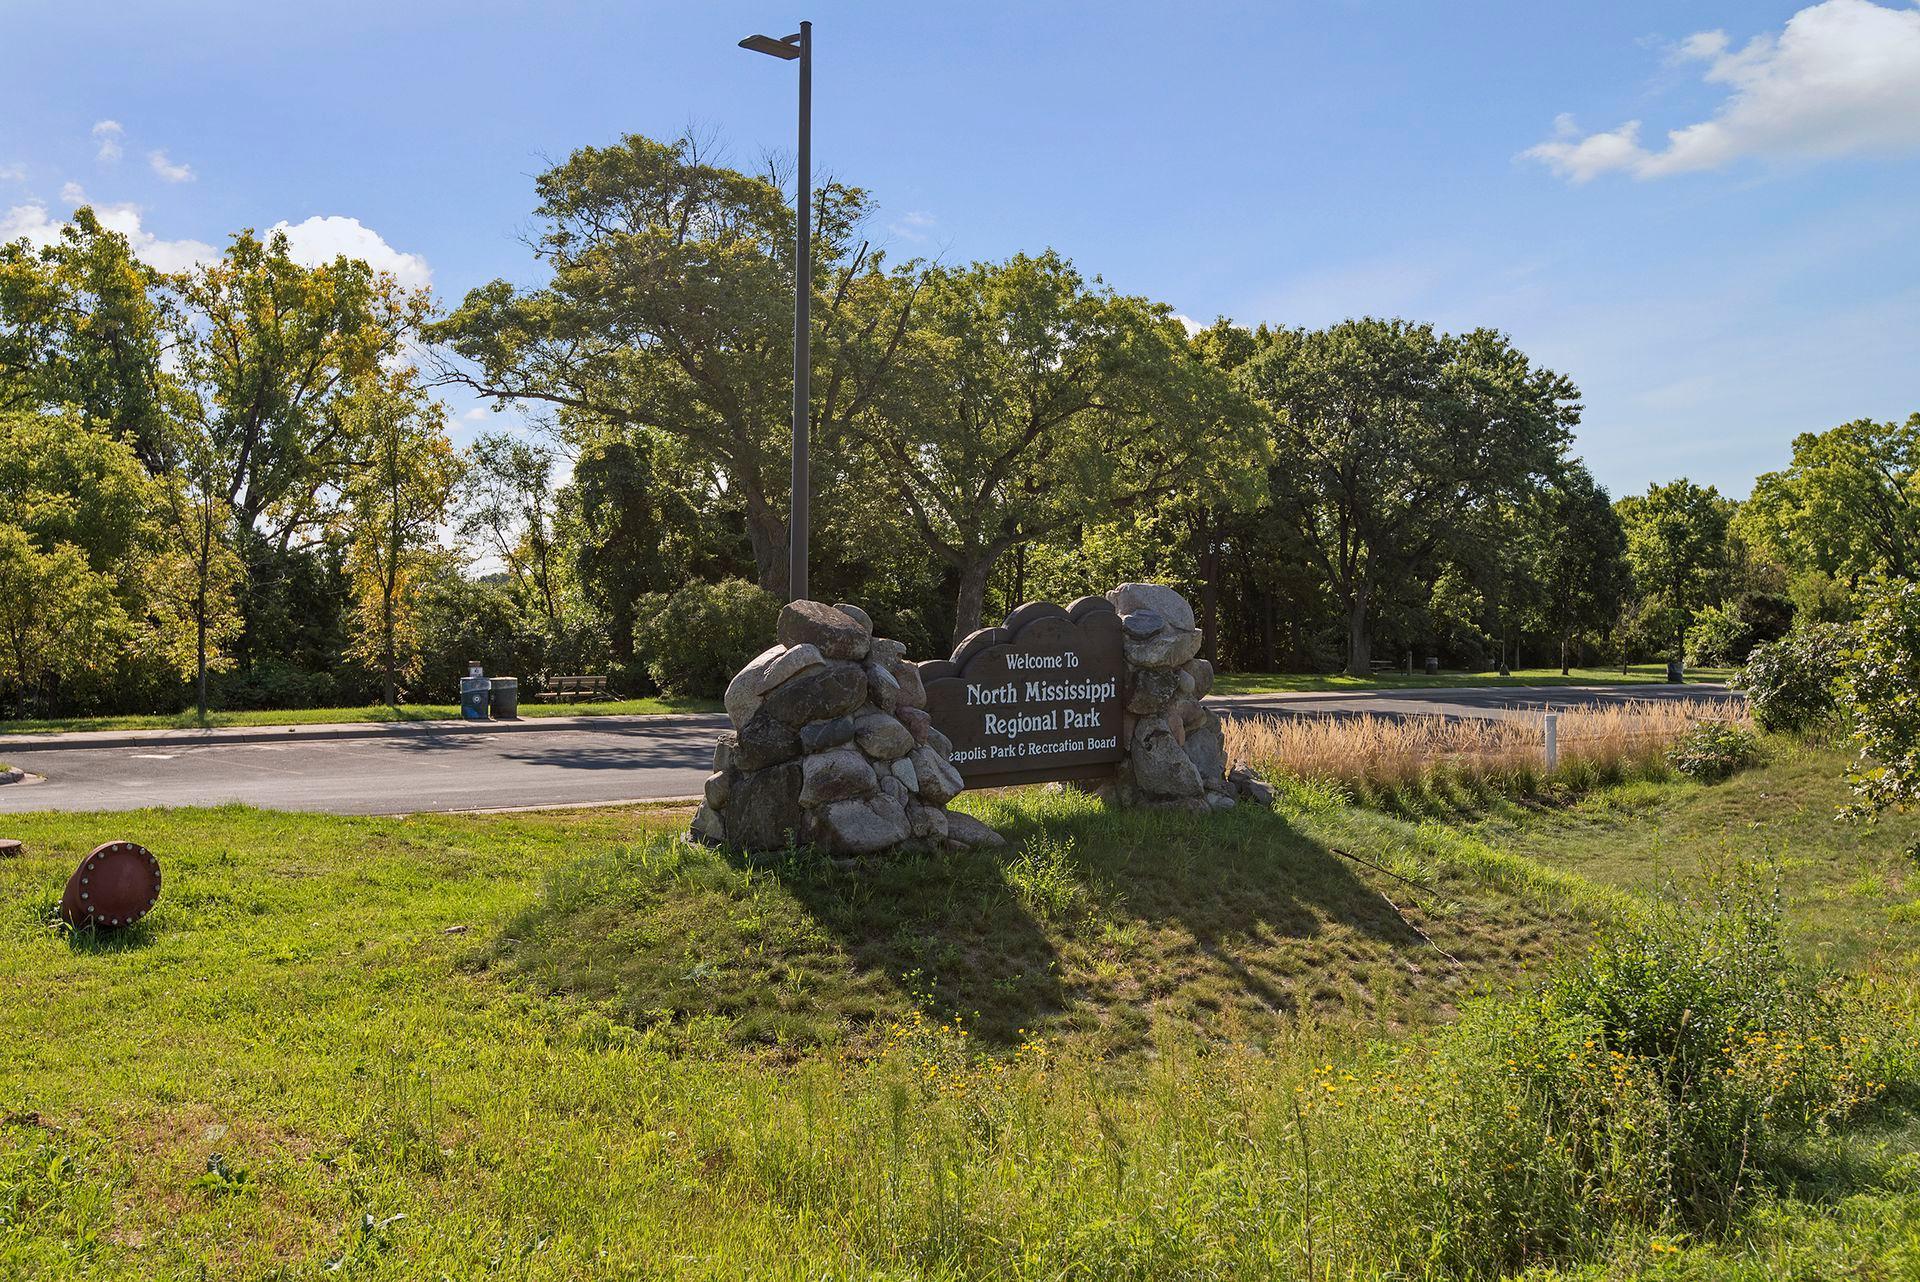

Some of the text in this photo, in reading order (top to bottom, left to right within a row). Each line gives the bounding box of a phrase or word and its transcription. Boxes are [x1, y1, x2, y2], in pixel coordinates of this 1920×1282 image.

[1006, 651, 1079, 670] Welcome To
[966, 677, 1116, 705] North Mississippi
[984, 707, 1101, 739] Regional Park
[990, 743, 1016, 759] Park
[1018, 743, 1026, 756] &
[1028, 739, 1084, 755] Recreation
[1087, 735, 1117, 750] Board
